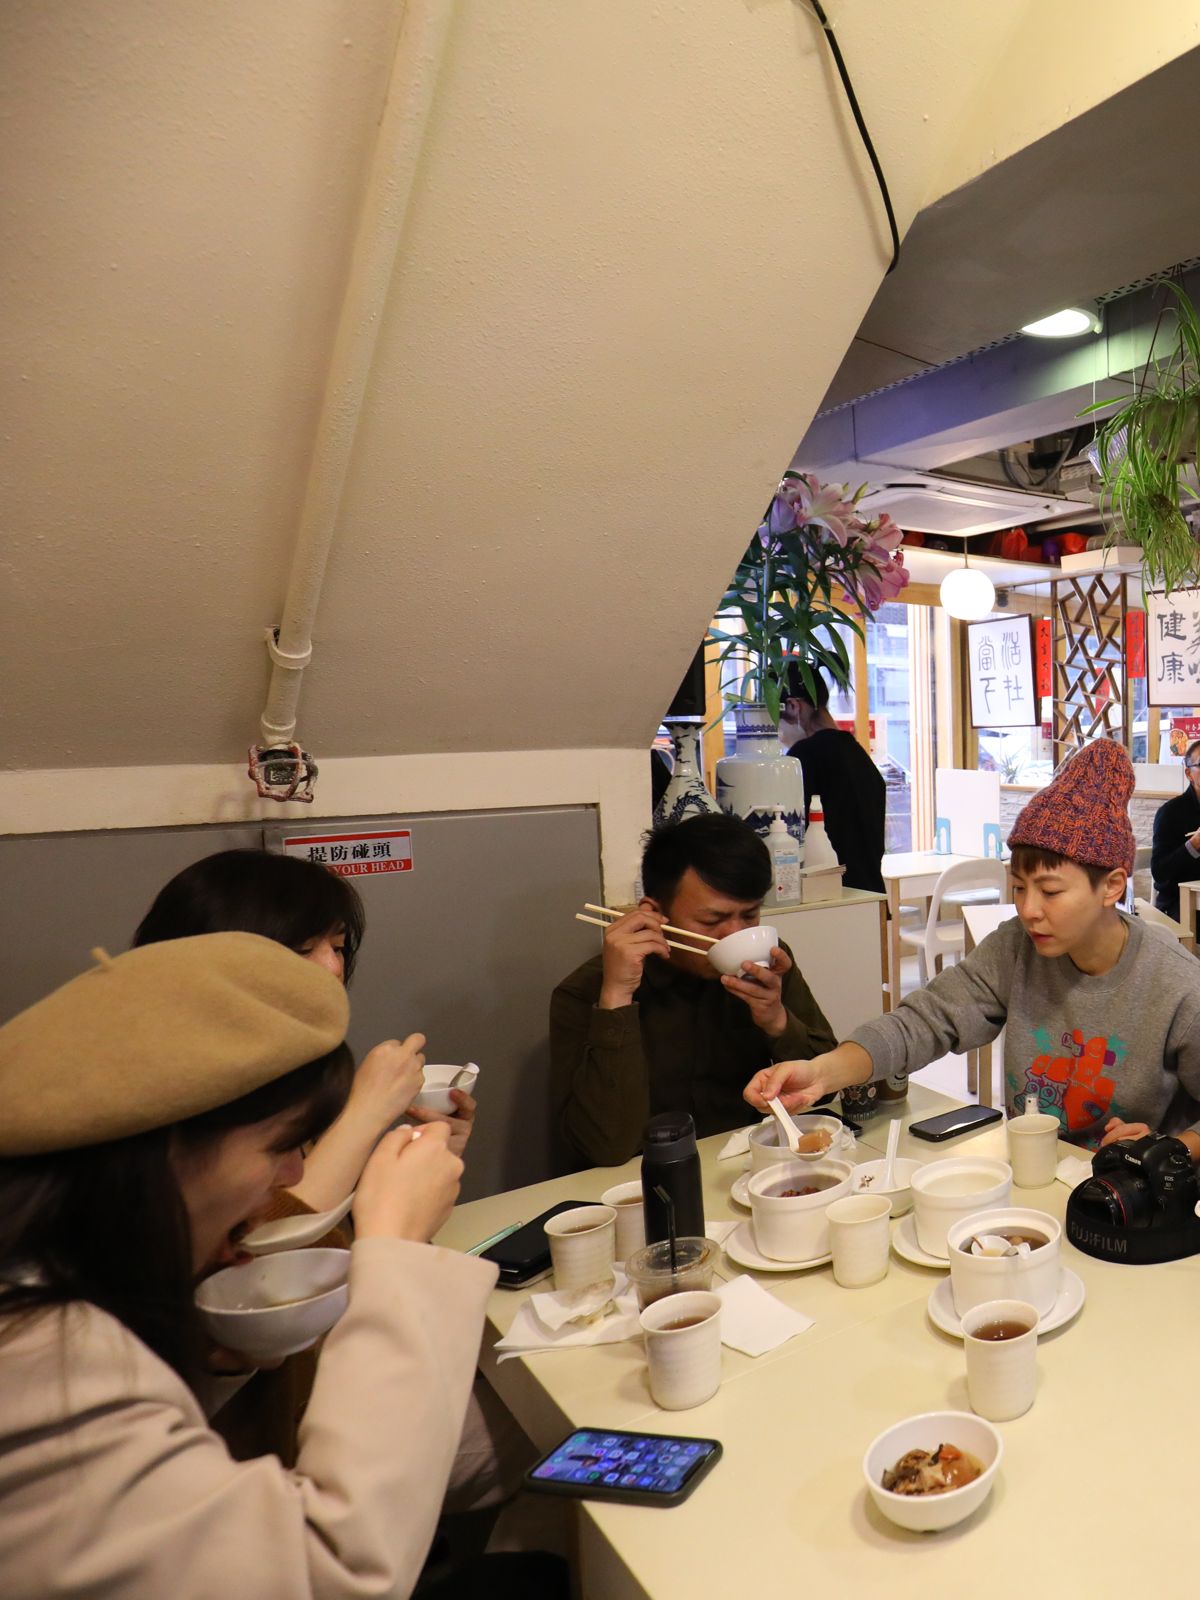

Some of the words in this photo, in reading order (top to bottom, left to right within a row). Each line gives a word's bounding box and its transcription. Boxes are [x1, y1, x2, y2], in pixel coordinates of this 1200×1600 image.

[1156, 610, 1187, 684] 健康
[308, 841, 392, 863] 提防碰頭
[371, 860, 404, 872] HEAD
[1124, 1154, 1142, 1166] Canon
[1071, 1221, 1128, 1254] FUJIFILM
